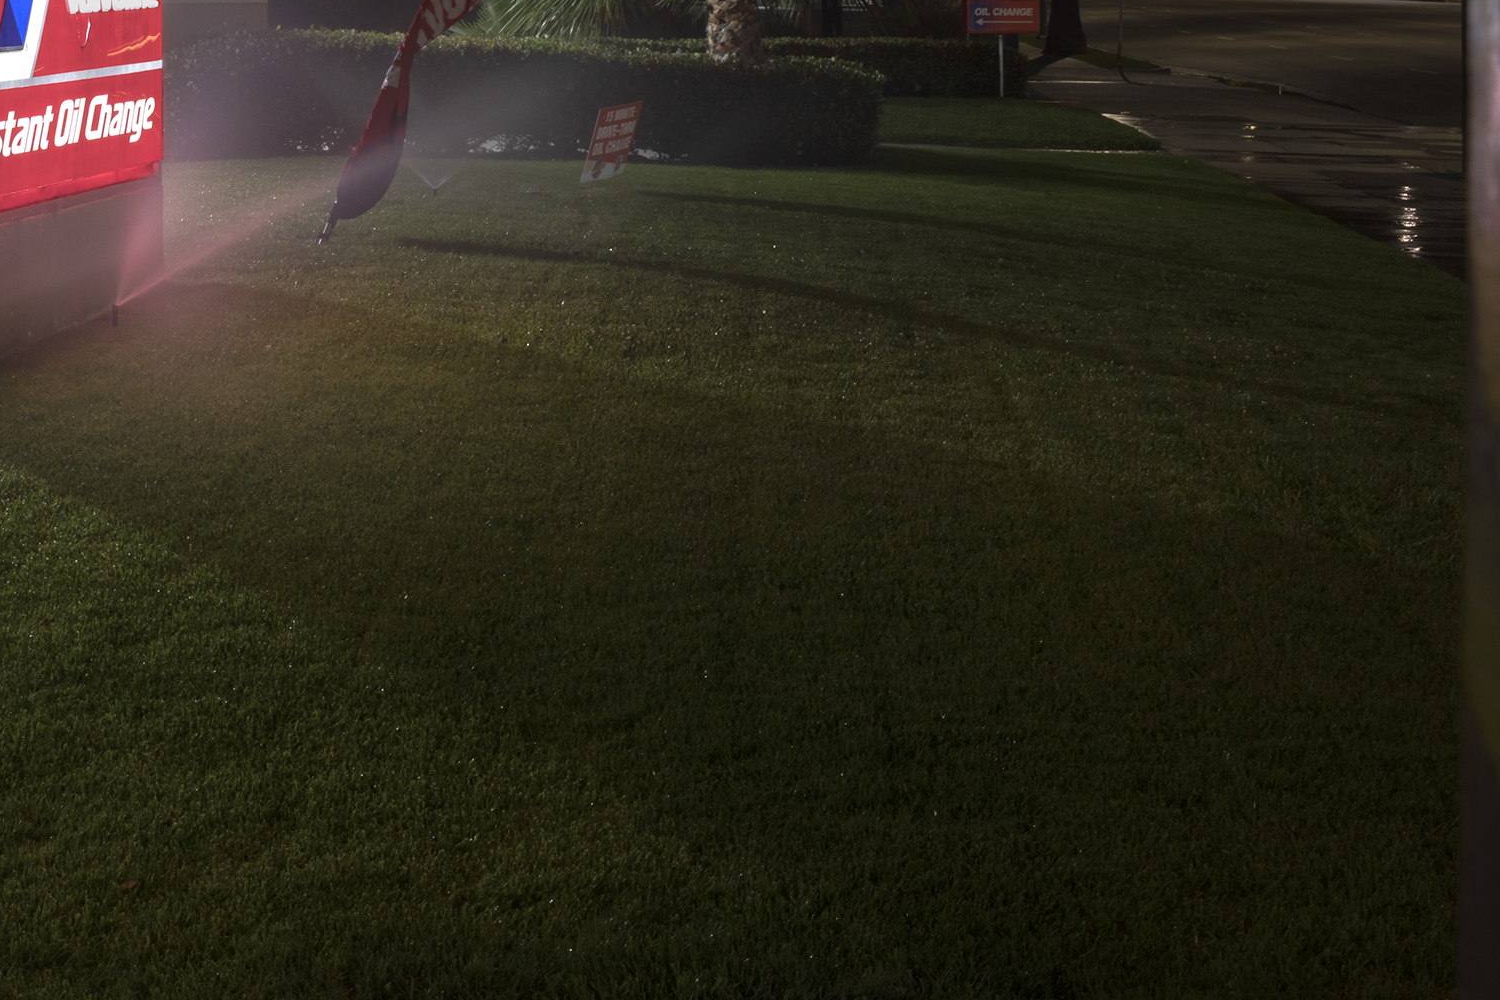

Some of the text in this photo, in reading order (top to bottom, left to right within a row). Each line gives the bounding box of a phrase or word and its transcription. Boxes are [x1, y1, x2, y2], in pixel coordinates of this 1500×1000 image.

[974, 7, 1033, 16] OIL CHANGE
[54, 97, 87, 147] Oil
[85, 94, 156, 143] Change
[606, 111, 614, 122] 15
[592, 142, 604, 156] OIL
